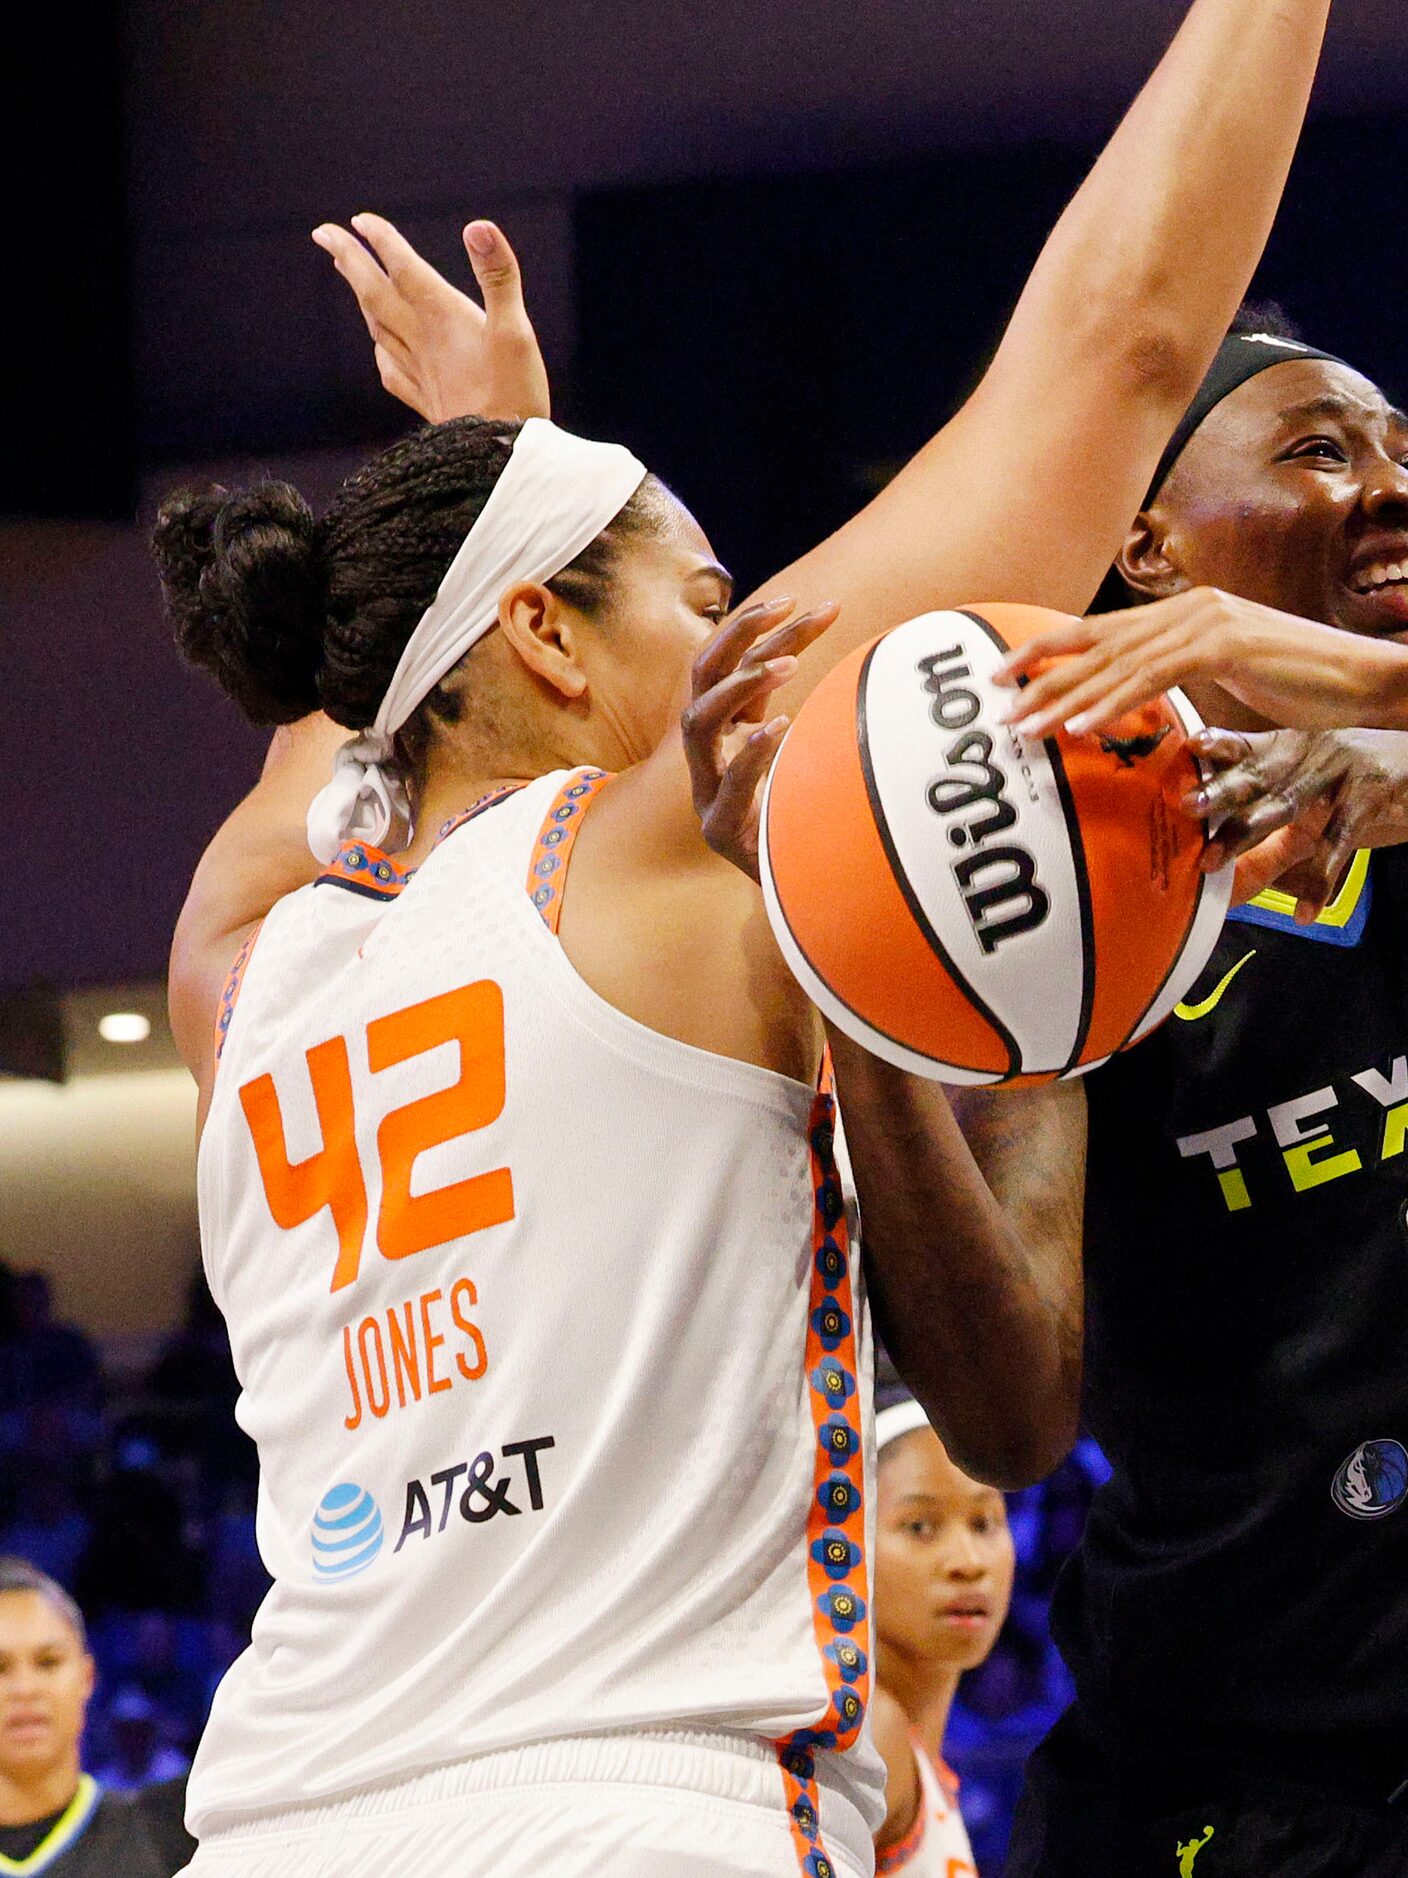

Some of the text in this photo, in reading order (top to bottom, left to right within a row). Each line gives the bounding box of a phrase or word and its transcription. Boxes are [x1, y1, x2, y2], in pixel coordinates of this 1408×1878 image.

[915, 640, 1051, 956] Wilson
[239, 979, 515, 1293] 42
[344, 1278, 488, 1430] JONES
[393, 1436, 555, 1554] AT&T
